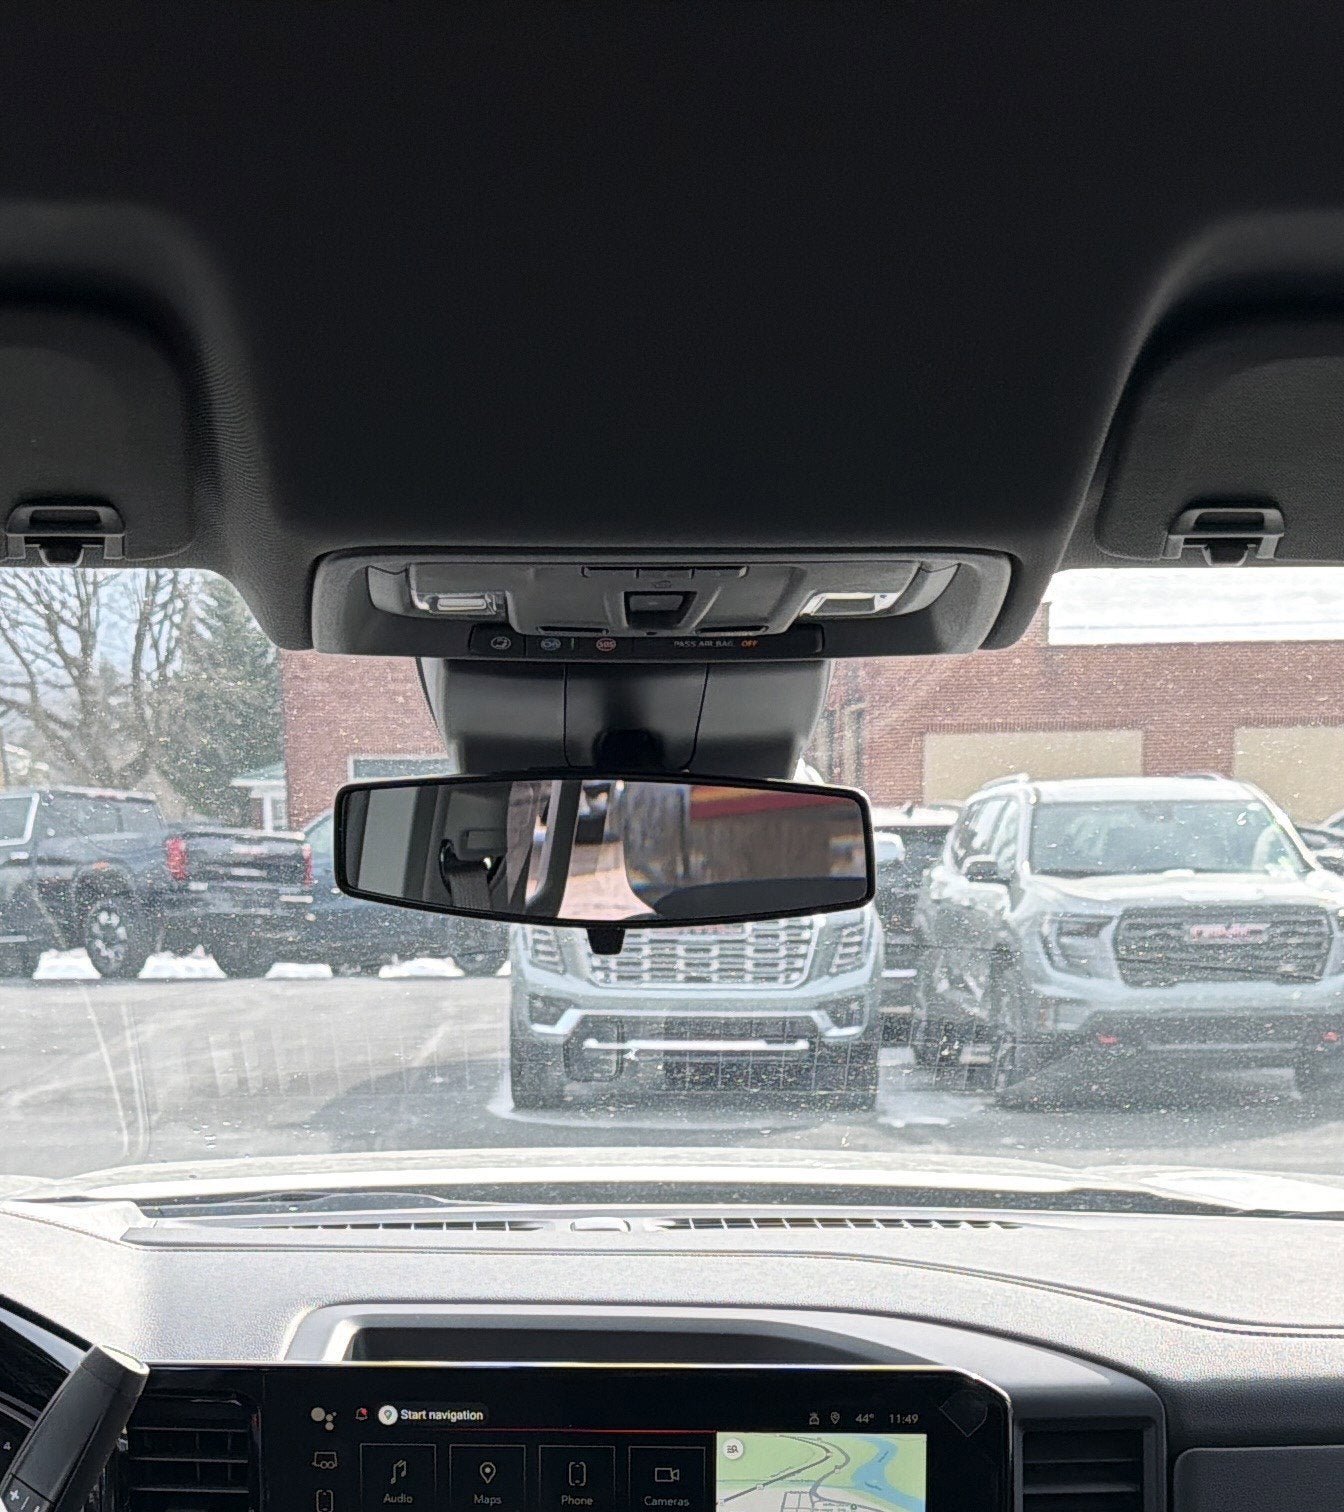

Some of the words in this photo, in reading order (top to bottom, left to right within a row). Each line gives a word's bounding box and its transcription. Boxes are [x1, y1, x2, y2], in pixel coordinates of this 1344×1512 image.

[401, 1409, 426, 1420] Start
[428, 1409, 484, 1423] navigation
[889, 1413, 919, 1424] 11:49
[383, 1493, 413, 1504] Audio
[474, 1494, 502, 1506] Maps
[561, 1494, 594, 1506] Phone
[644, 1495, 690, 1507] Cameras
